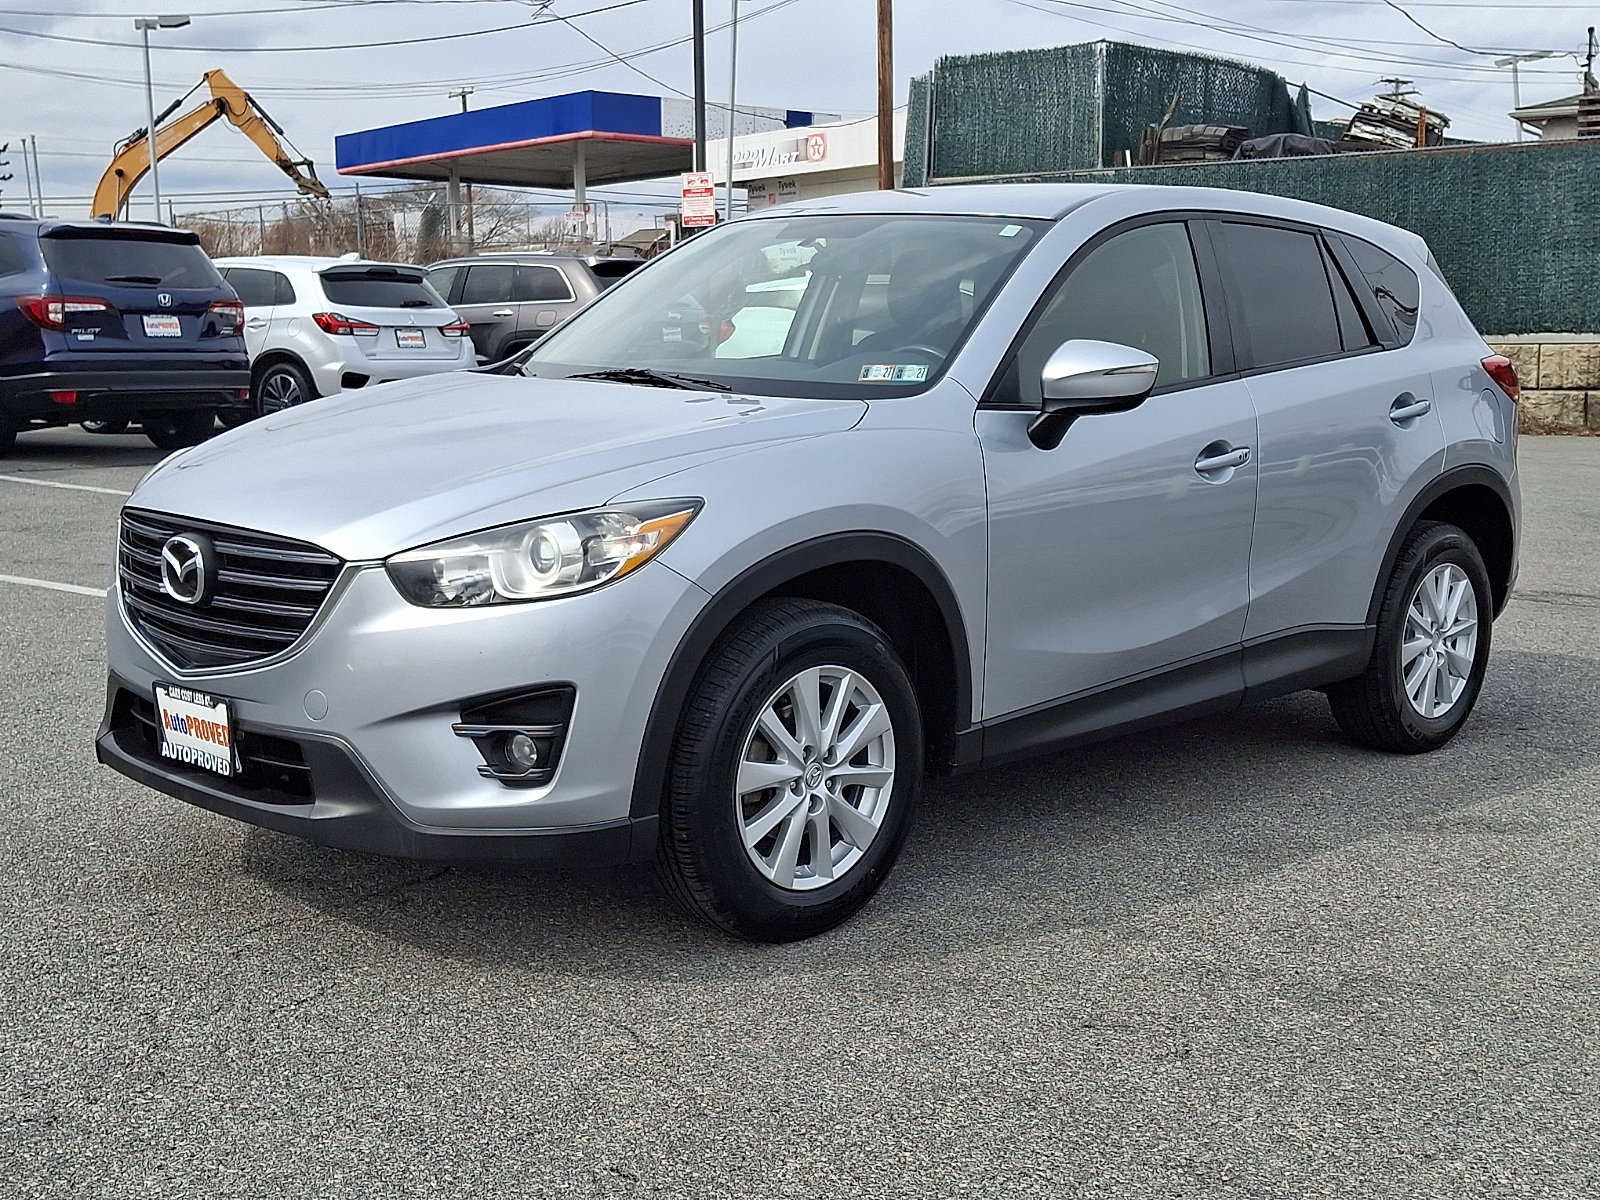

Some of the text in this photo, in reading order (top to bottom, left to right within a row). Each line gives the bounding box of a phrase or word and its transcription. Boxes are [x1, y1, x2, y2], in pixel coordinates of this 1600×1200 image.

[748, 183, 766, 195] Tyvek
[778, 180, 797, 191] Tyvek
[71, 327, 102, 335] PILOT
[883, 367, 892, 378] 27
[916, 367, 926, 379] 27
[168, 685, 181, 699] CARS
[180, 688, 193, 703] COST
[193, 691, 205, 706] LESS
[163, 708, 231, 747] AutoPROVED
[161, 741, 230, 776] AUTOPROVED
